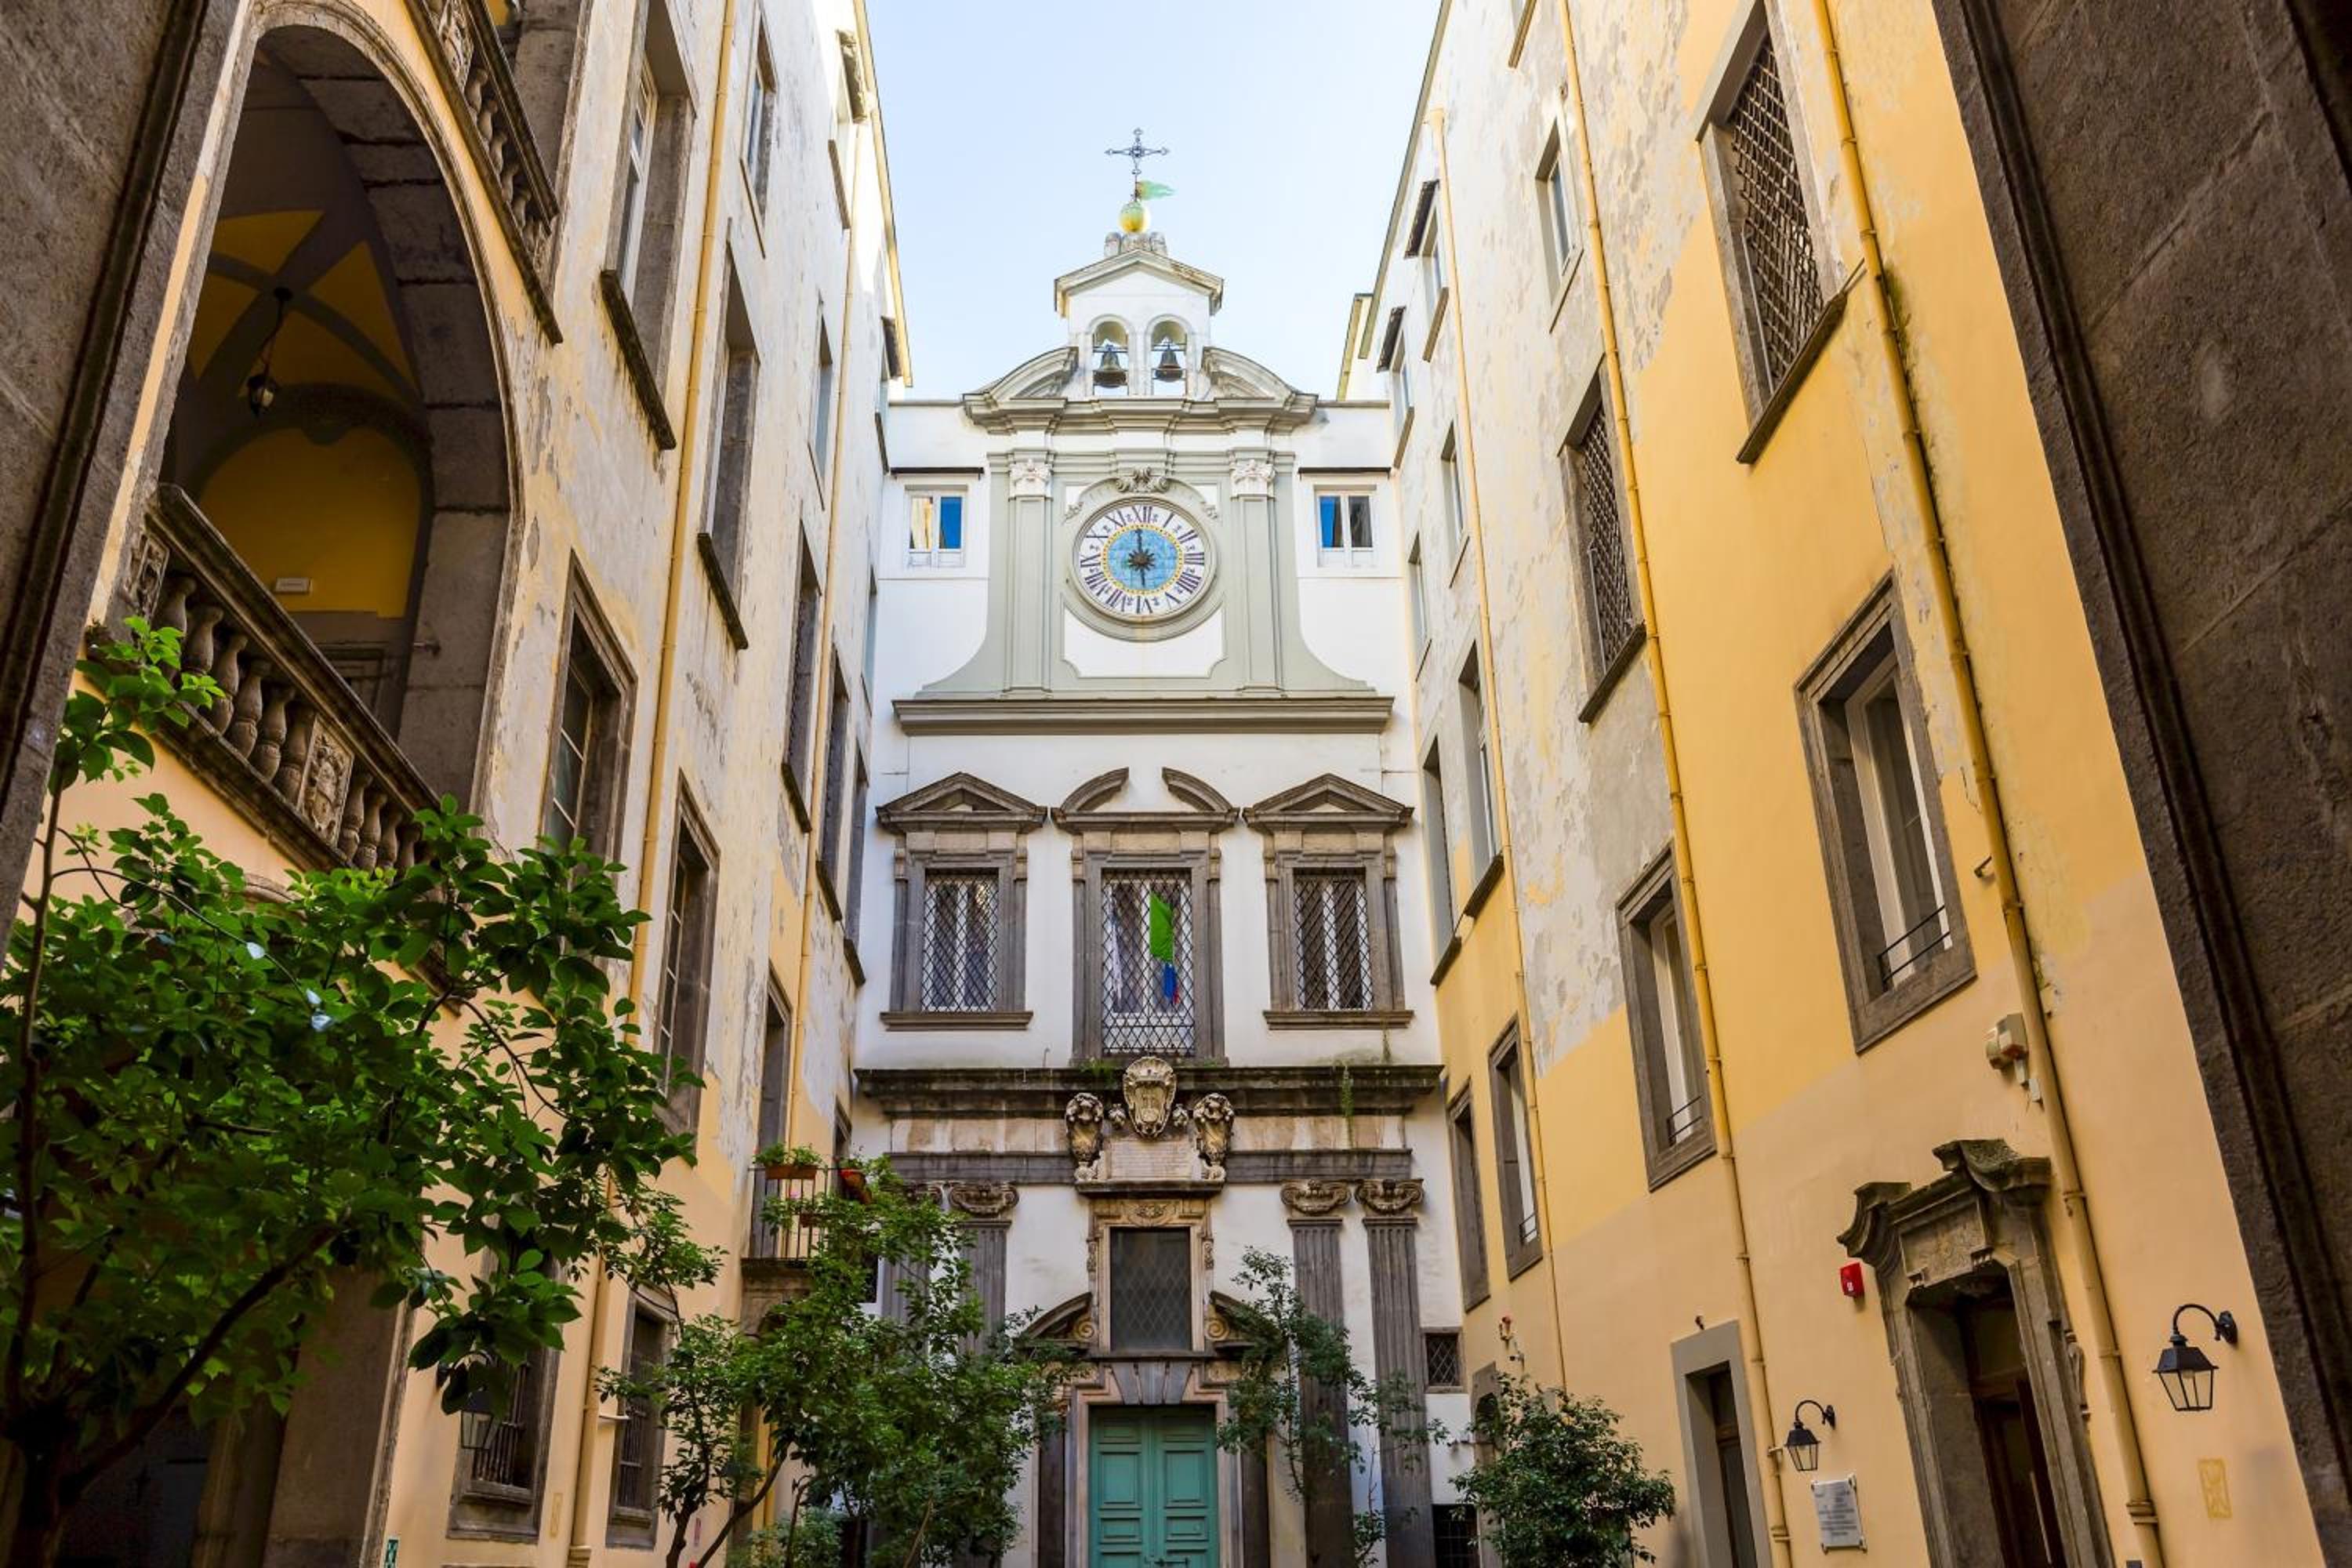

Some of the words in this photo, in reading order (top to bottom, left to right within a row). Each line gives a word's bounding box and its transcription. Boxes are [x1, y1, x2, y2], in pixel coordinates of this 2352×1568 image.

[1105, 509, 1127, 528] XI
[1131, 506, 1152, 523] XII
[1163, 511, 1174, 528] I
[1086, 529, 1109, 544] X
[1178, 529, 1199, 543] II
[1080, 554, 1101, 568] IX
[1185, 552, 1205, 565] III
[1084, 572, 1109, 596] VIII
[1176, 572, 1201, 594] IIII
[1105, 589, 1127, 612] VII
[1136, 596, 1153, 614] VI
[1164, 592, 1181, 610] V
